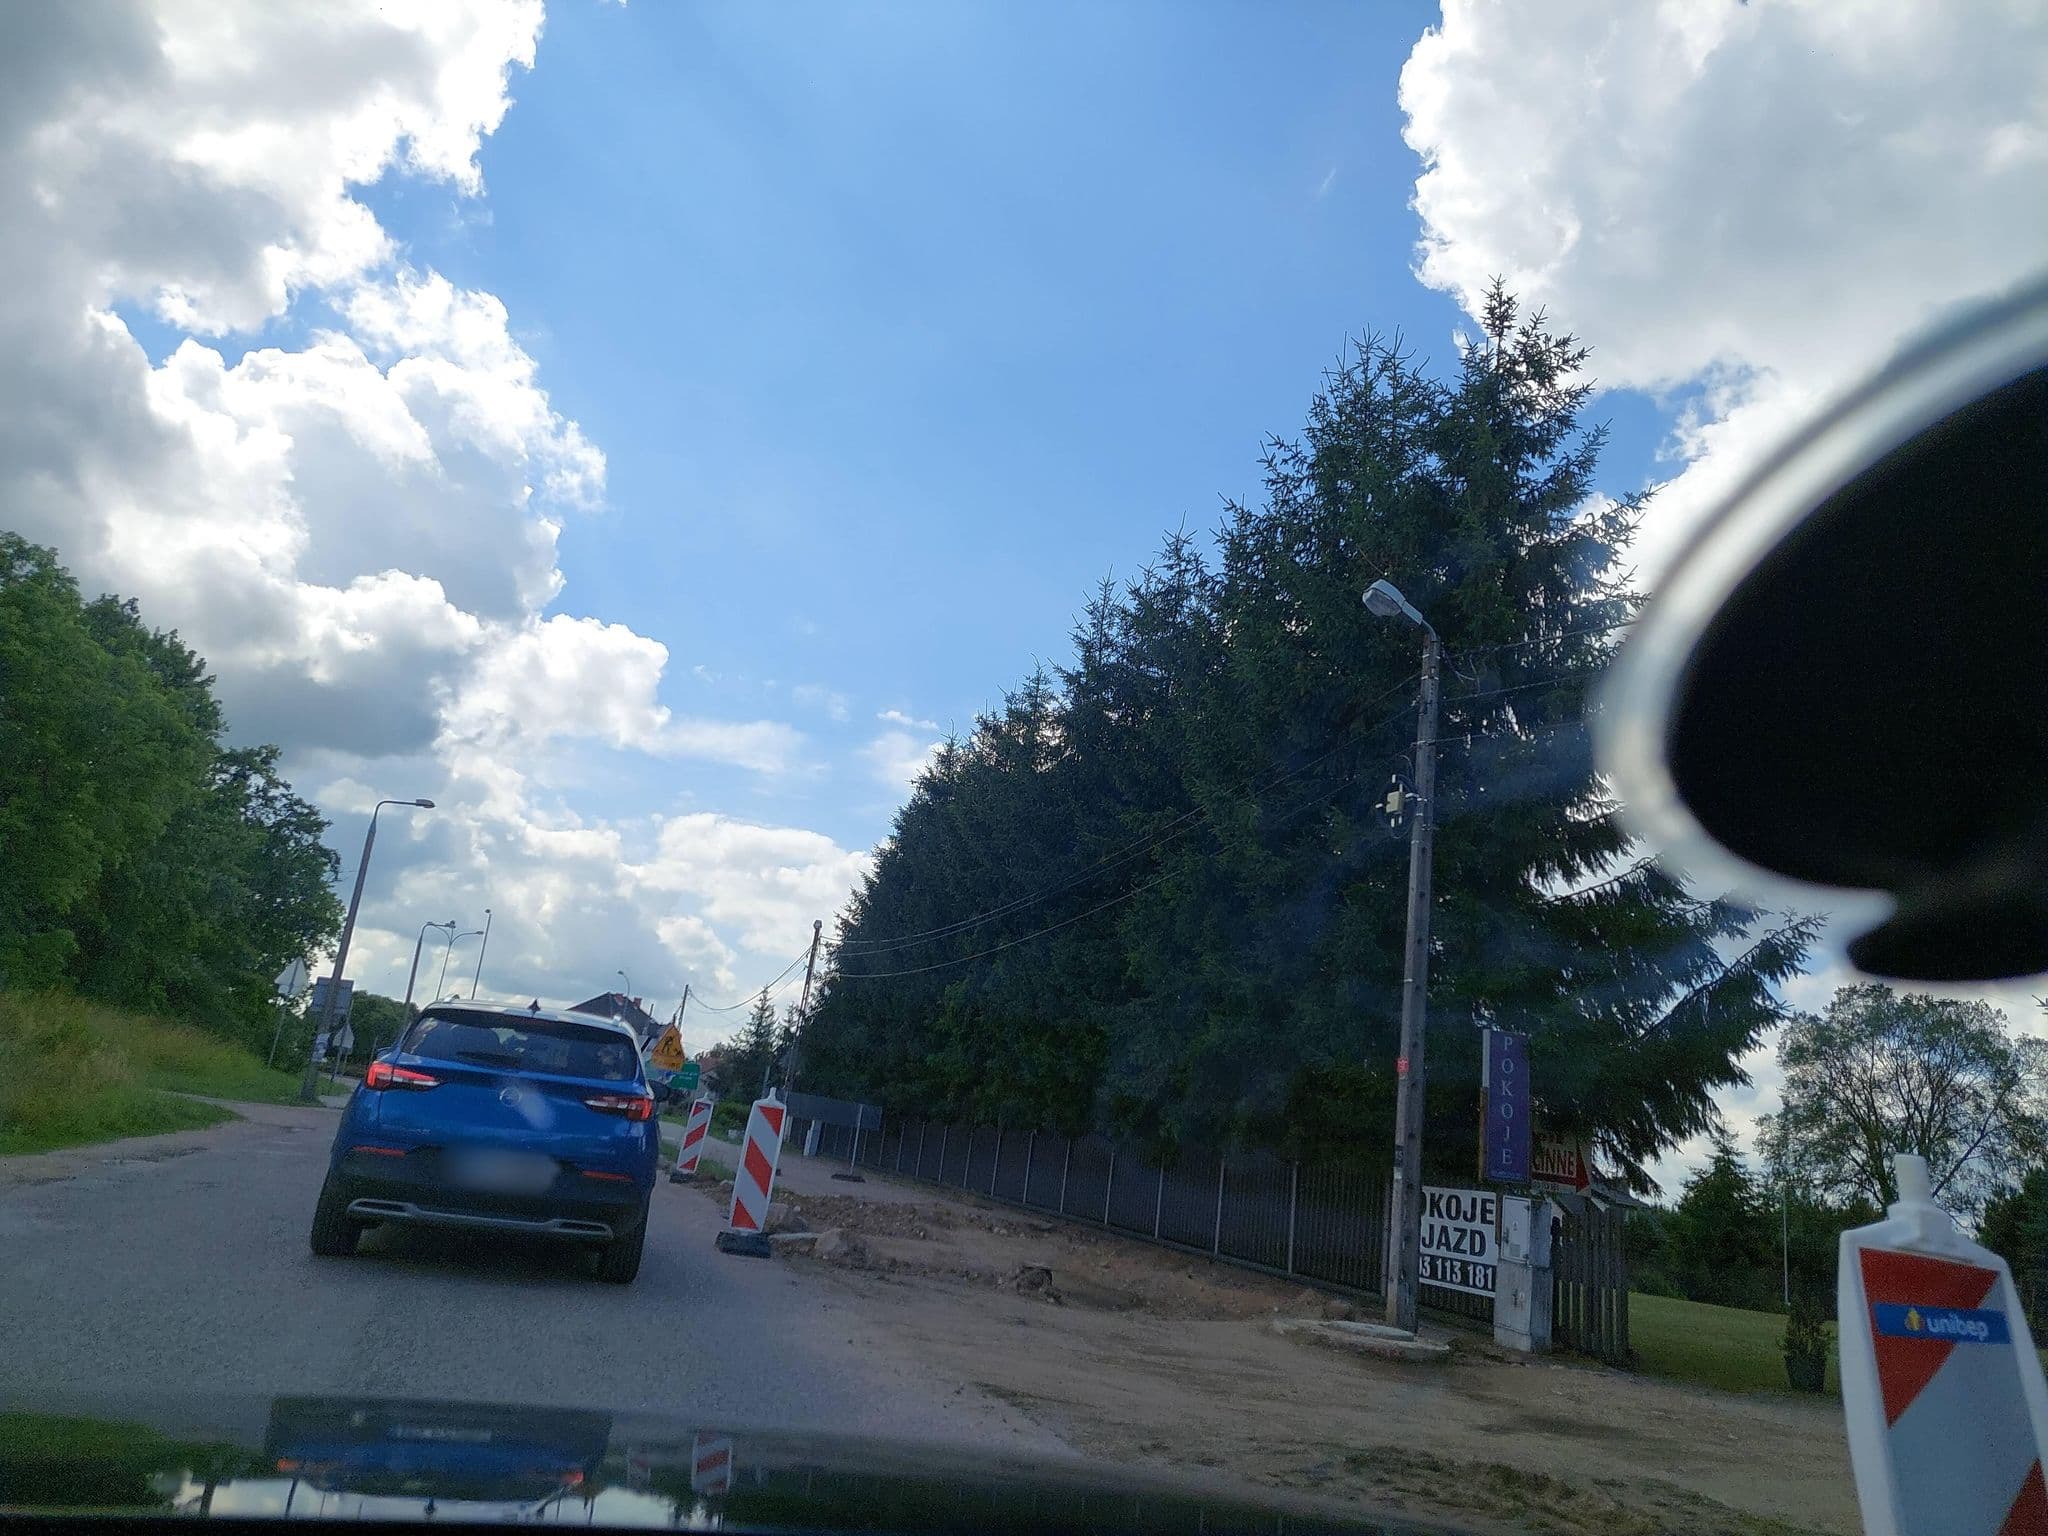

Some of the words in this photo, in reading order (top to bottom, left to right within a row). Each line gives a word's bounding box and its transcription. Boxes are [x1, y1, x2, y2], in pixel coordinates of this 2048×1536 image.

[1501, 1036, 1514, 1165] POKOJE
[1421, 1223, 1487, 1258] JAZD
[1436, 1258, 1462, 1284] 113
[1467, 1263, 1493, 1290] 181
